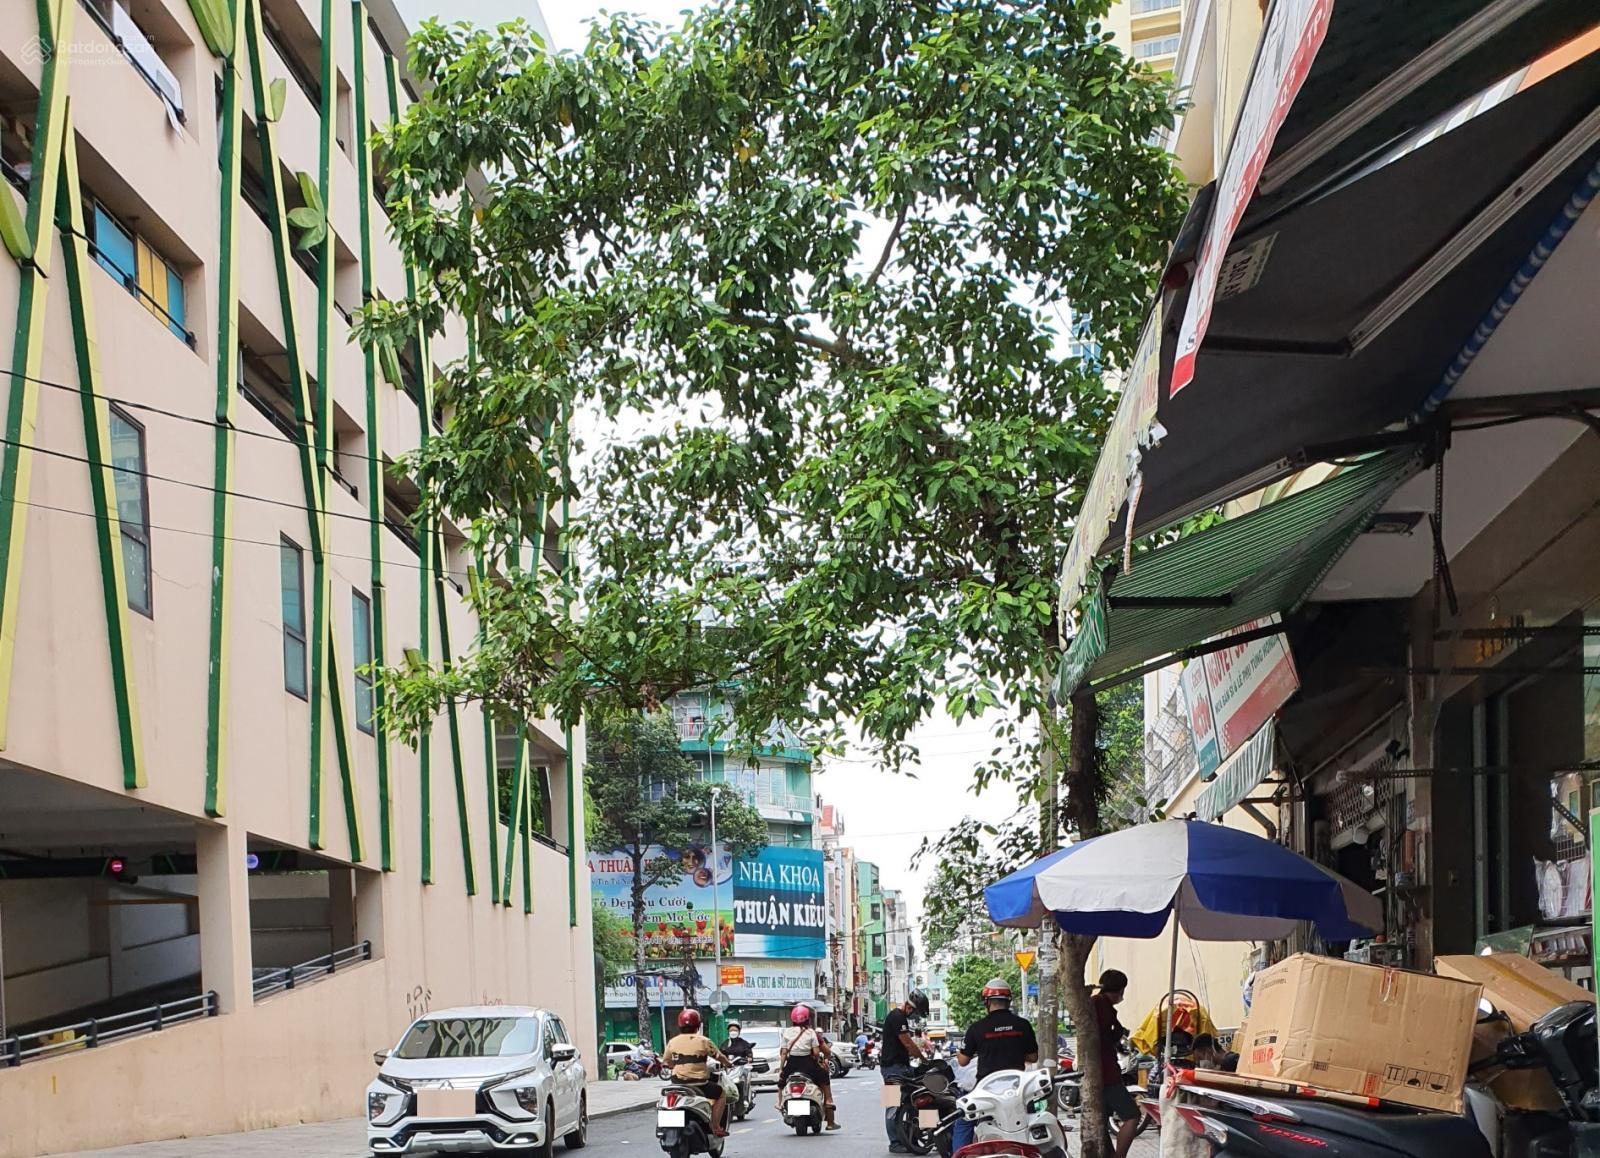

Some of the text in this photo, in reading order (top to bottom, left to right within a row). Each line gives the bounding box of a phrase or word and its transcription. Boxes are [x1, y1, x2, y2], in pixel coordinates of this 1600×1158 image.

[598, 857, 635, 875] THUẬ
[739, 861, 820, 887] NHA KHOA
[658, 897, 687, 907] Cười
[733, 893, 825, 930] THUẬN KIỀU
